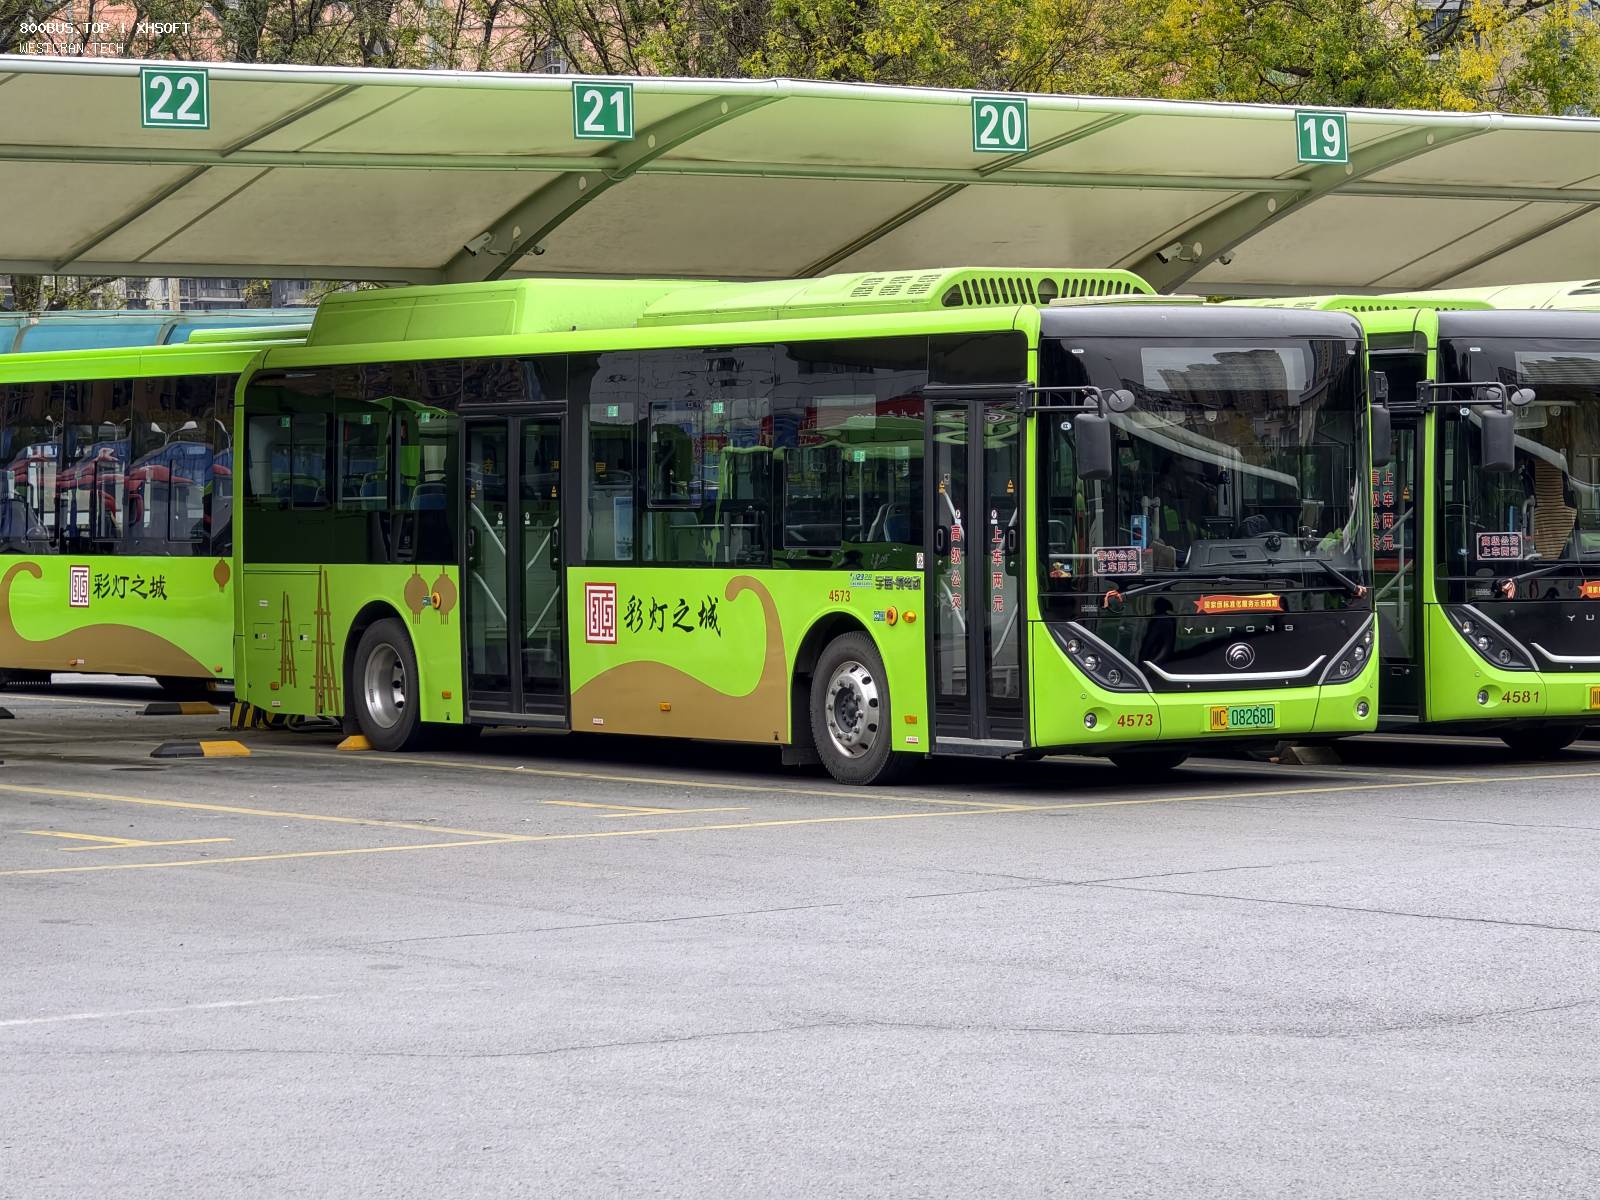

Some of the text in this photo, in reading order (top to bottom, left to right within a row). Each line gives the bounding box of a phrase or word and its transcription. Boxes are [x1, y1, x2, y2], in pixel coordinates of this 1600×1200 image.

[150, 75, 200, 120] 22
[583, 89, 625, 132] 21
[980, 105, 1021, 145] 20
[1304, 118, 1341, 157] 19
[1383, 469, 1394, 551] 上车两元
[951, 524, 961, 610] 高级公交
[992, 525, 1004, 612] 上车两元
[93, 574, 168, 601] 彩灯之城
[829, 590, 851, 602] 4573
[623, 594, 722, 638] 彩灯之城
[1184, 624, 1294, 634] YUTONG
[1502, 691, 1539, 703] 4581
[1117, 714, 1153, 727] 4573
